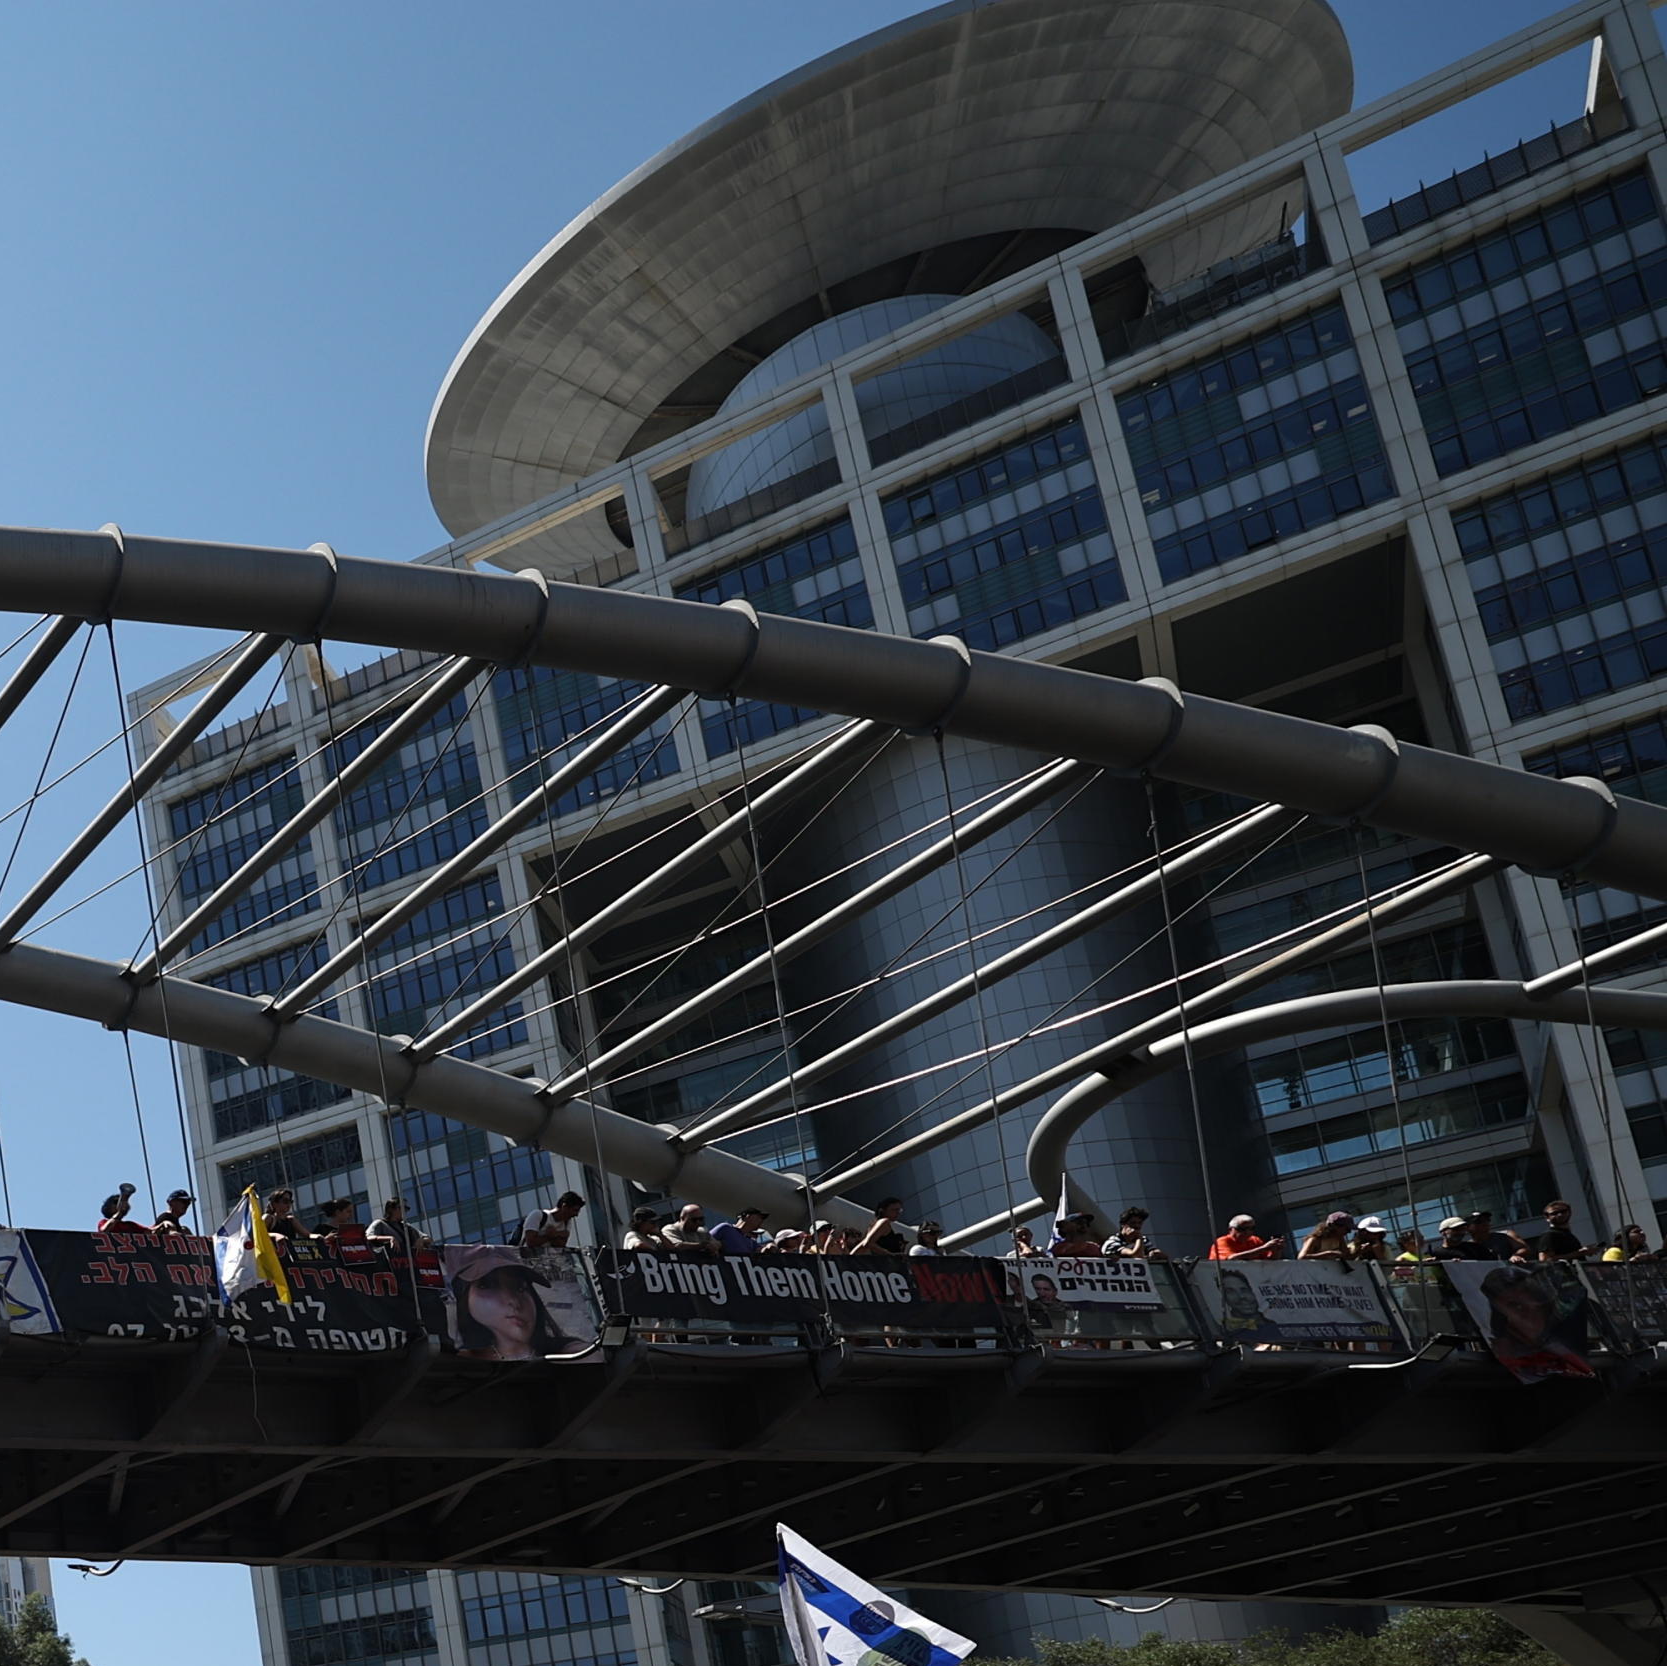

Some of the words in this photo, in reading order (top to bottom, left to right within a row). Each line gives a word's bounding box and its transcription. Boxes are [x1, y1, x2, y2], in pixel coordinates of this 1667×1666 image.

[80, 1256, 158, 1286] הלב.
[166, 1263, 216, 1287] את
[636, 1252, 729, 1306] Bring
[725, 1255, 819, 1301] Them
[823, 1258, 913, 1304] Home
[911, 1263, 1004, 1305] Now!
[1259, 1286, 1274, 1297] HE
[1292, 1285, 1307, 1296] NO
[1307, 1284, 1332, 1296] TIME
[1295, 1298, 1316, 1310] HIM
[1316, 1298, 1344, 1310] HOME
[306, 1325, 408, 1352] חטופה
